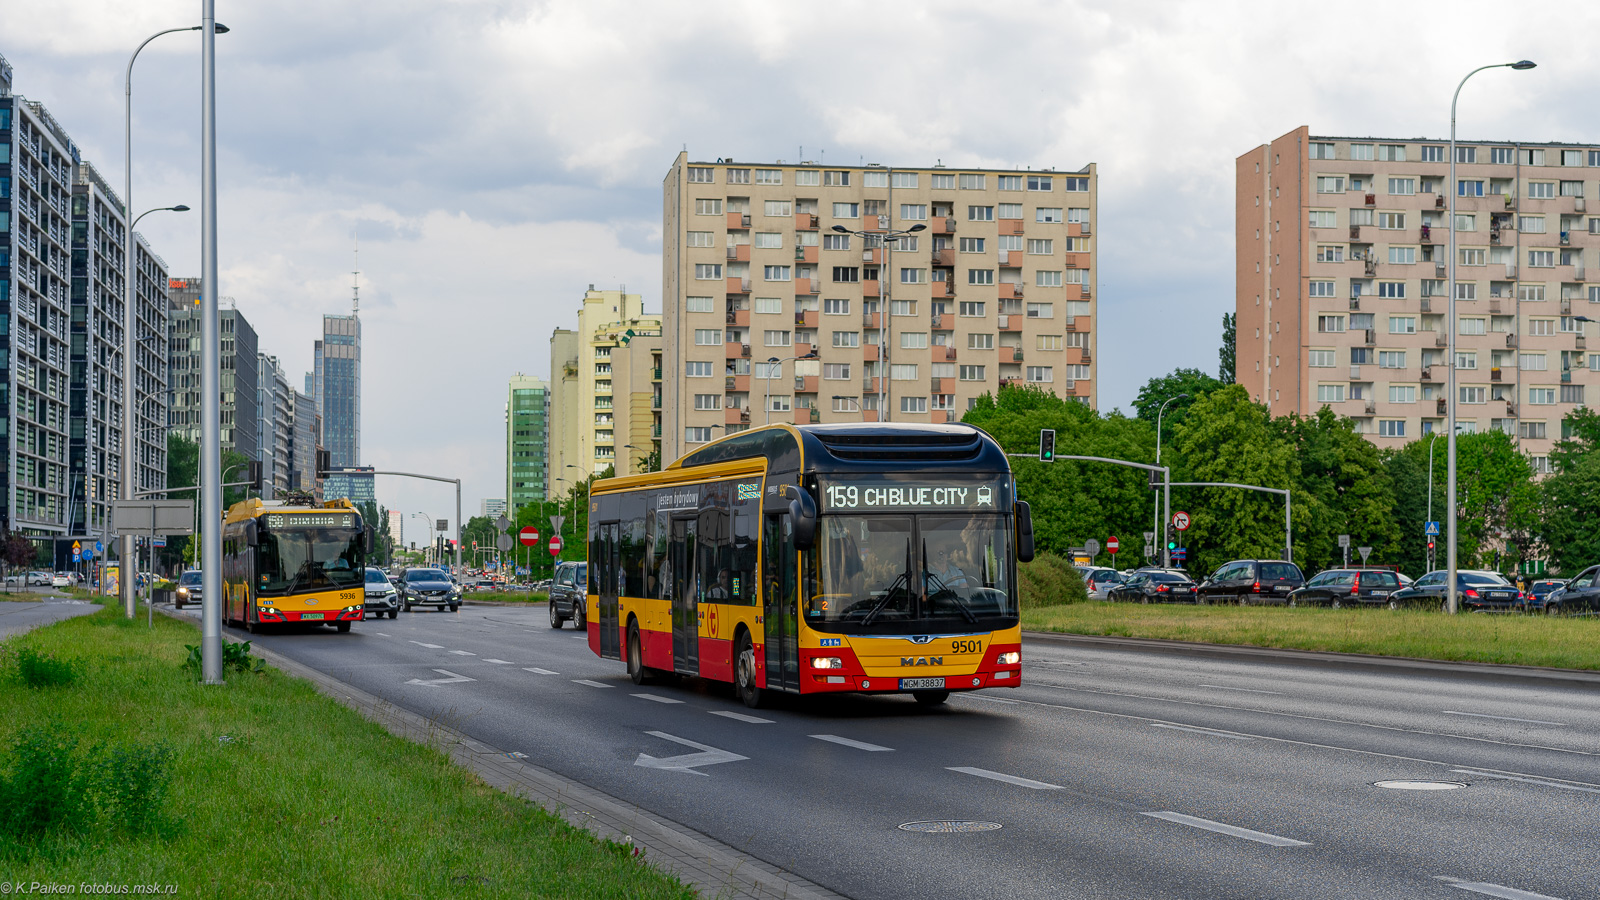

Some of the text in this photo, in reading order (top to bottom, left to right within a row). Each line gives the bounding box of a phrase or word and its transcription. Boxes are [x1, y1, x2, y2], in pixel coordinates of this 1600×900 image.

[826, 486, 968, 508] 159 CH BLUE CITY
[822, 600, 828, 610] 2
[952, 640, 982, 654] 9501
[900, 656, 943, 666] MAN
[902, 678, 944, 688] WGM 38837
